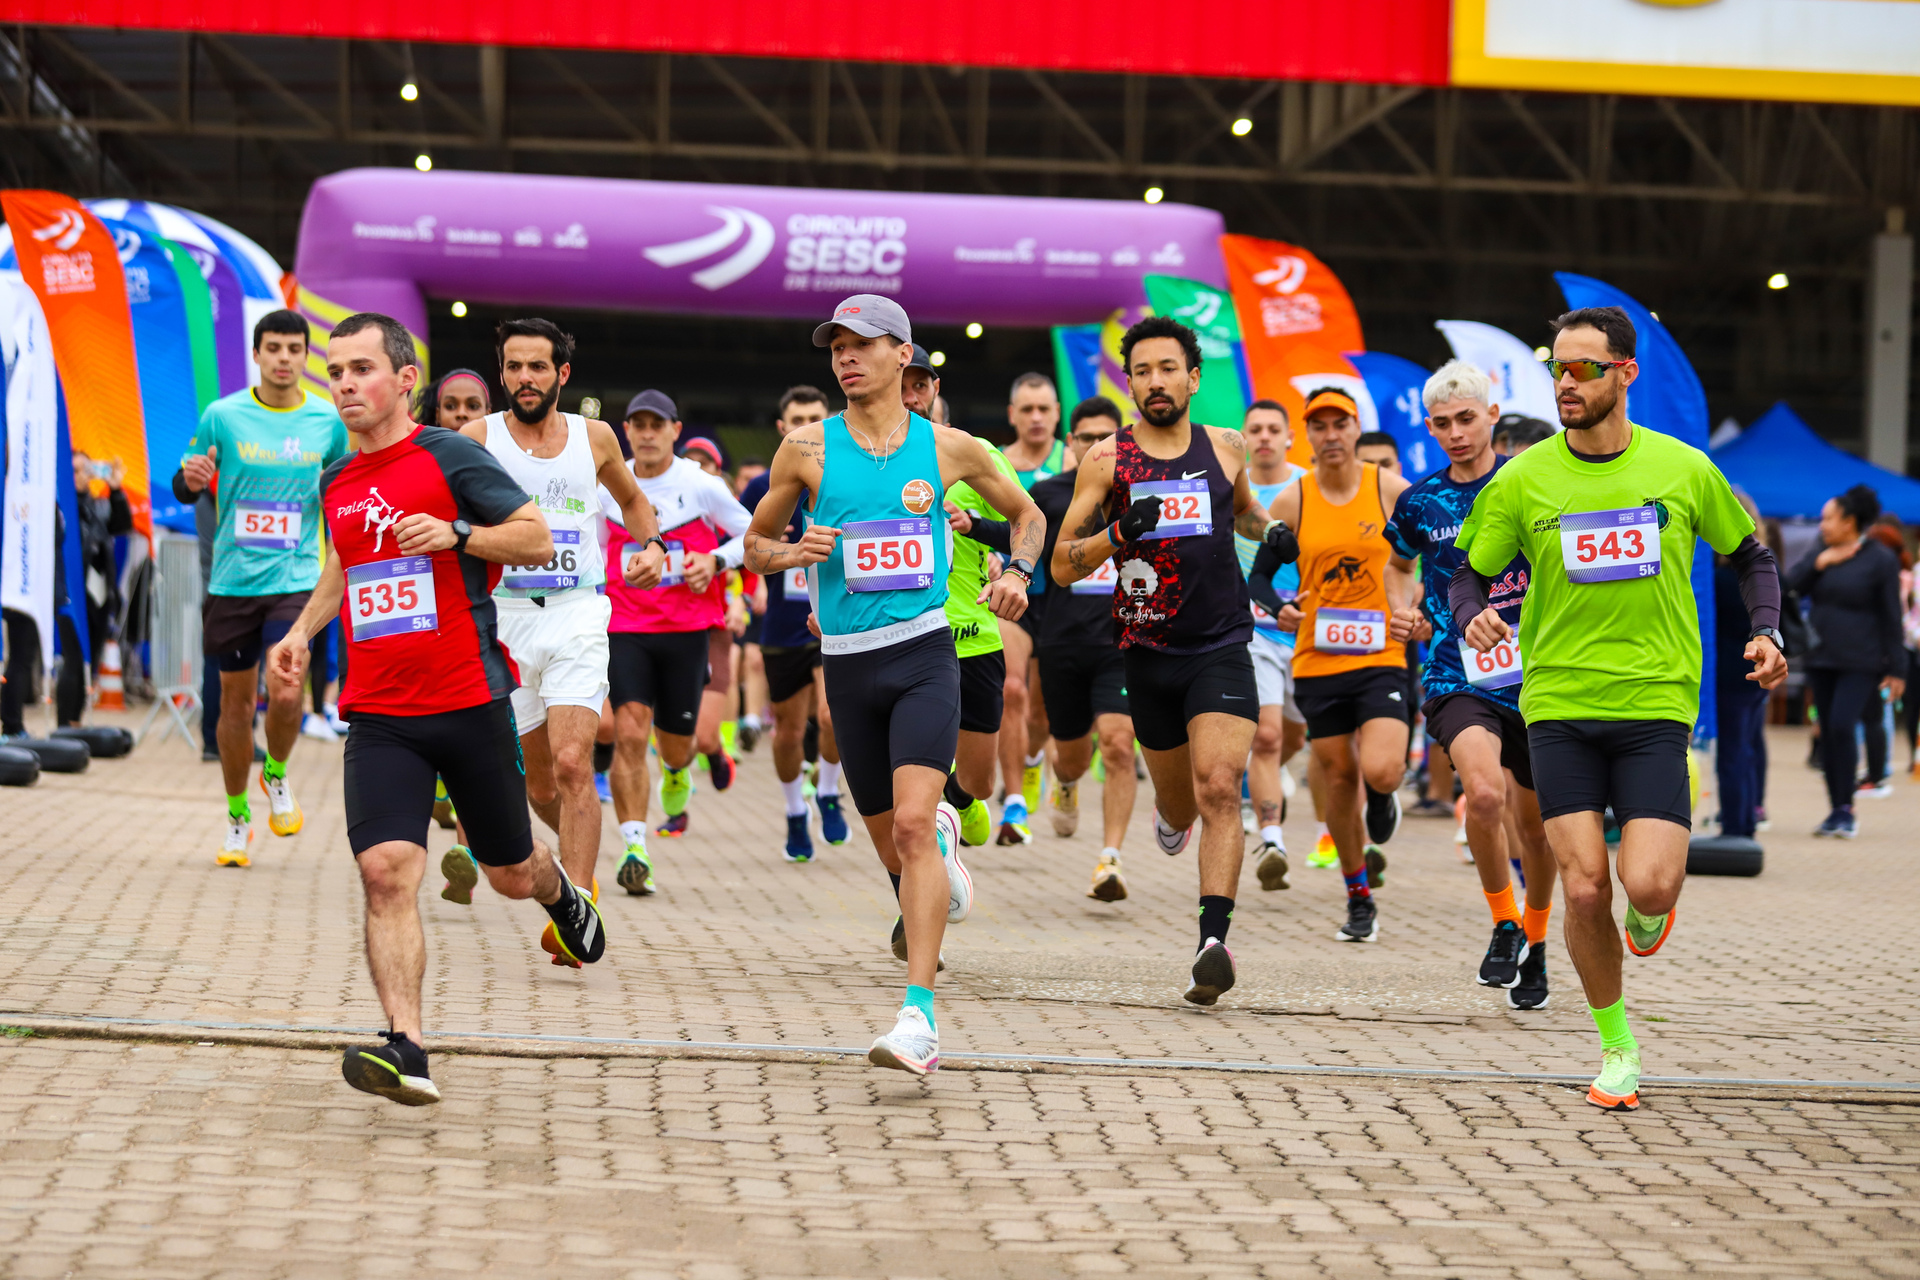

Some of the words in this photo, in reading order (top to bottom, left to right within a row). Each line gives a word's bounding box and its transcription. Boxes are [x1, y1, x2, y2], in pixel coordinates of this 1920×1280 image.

[786, 213, 907, 238] CIRCUITO
[784, 236, 907, 275] SESC
[1157, 495, 1201, 521] 82
[245, 513, 289, 534] 521
[1196, 524, 1209, 534] 5k
[857, 539, 922, 571] 550
[1576, 529, 1645, 563] 543
[511, 549, 577, 572] 86
[1639, 564, 1656, 576] 5k
[555, 576, 575, 587] 10k
[918, 575, 931, 587] 5k
[358, 579, 418, 617] 535
[412, 617, 432, 629] 5k
[884, 617, 939, 641] umbro
[1326, 623, 1373, 645] 663
[822, 640, 848, 650] bro
[1475, 643, 1521, 673] 60
